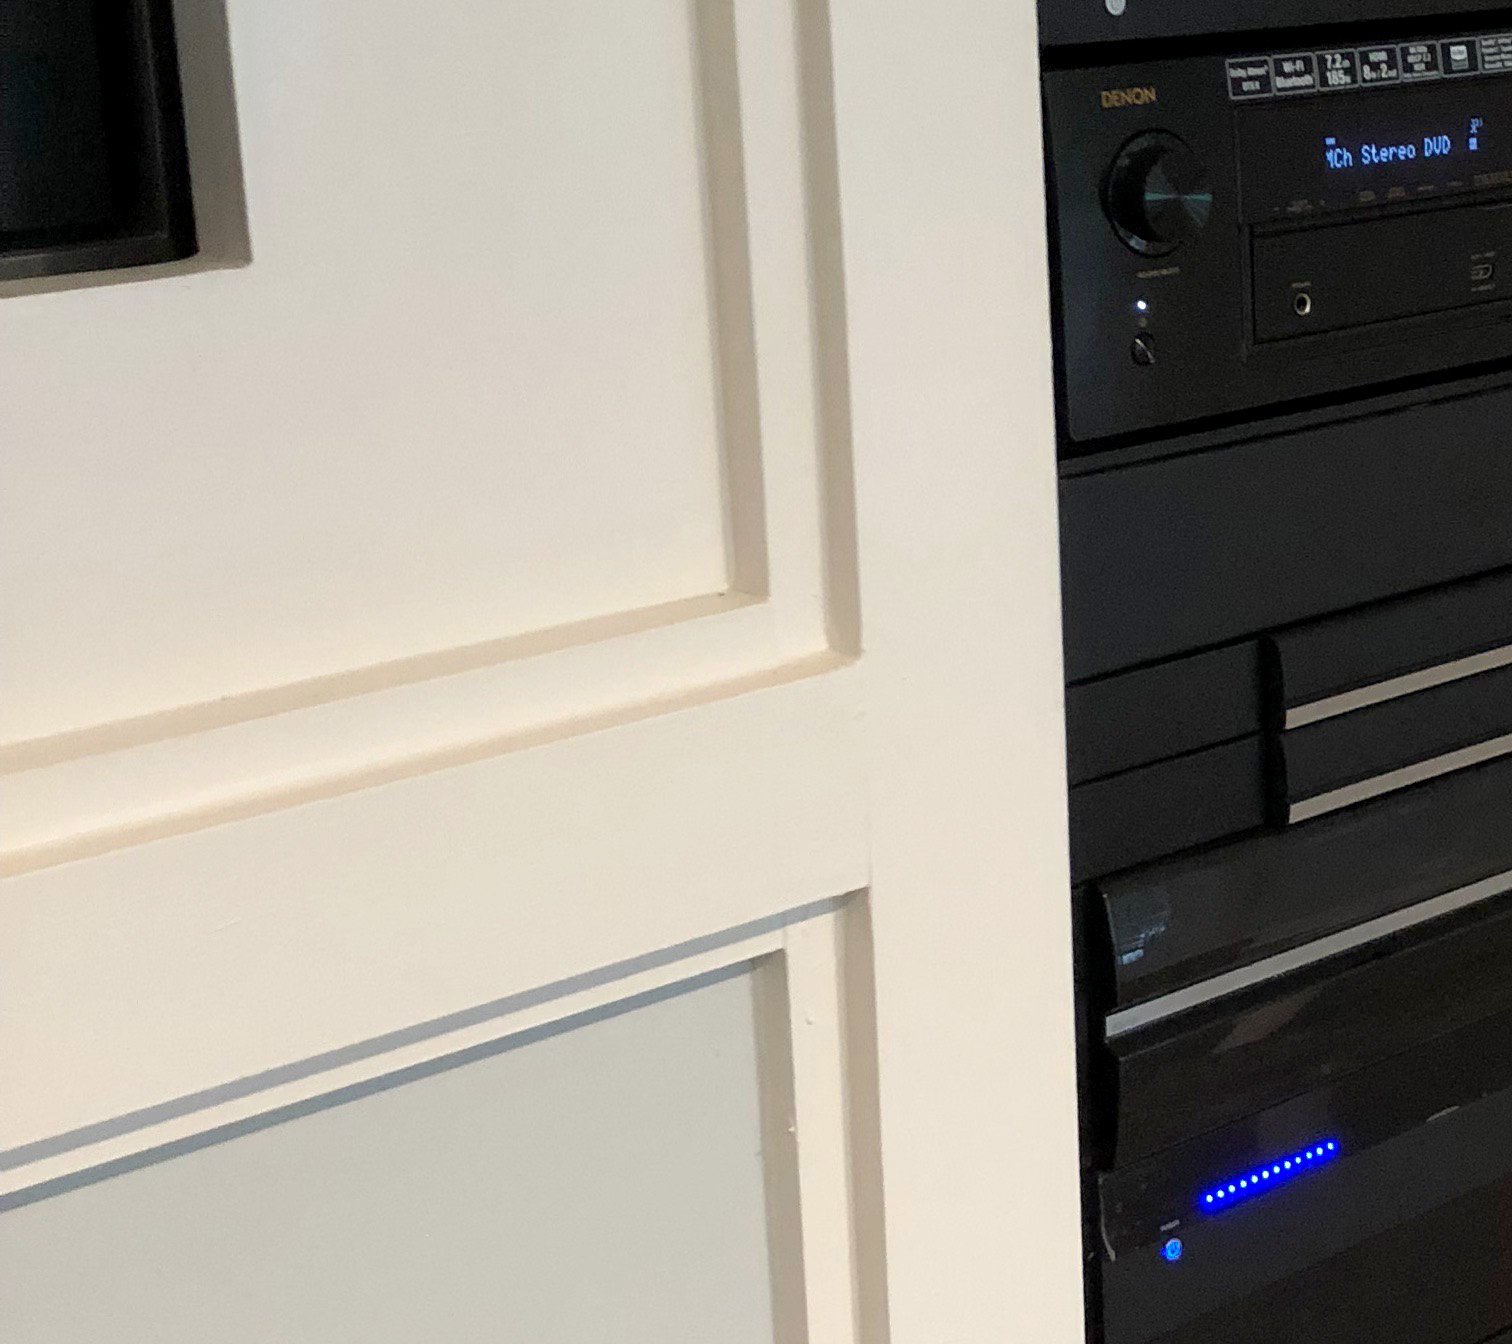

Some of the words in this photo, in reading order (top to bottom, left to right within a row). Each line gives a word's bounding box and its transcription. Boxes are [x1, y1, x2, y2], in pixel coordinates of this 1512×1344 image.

[1100, 85, 1158, 109] DENON
[1360, 142, 1417, 165] Stereo
[1423, 134, 1452, 158] DVD
